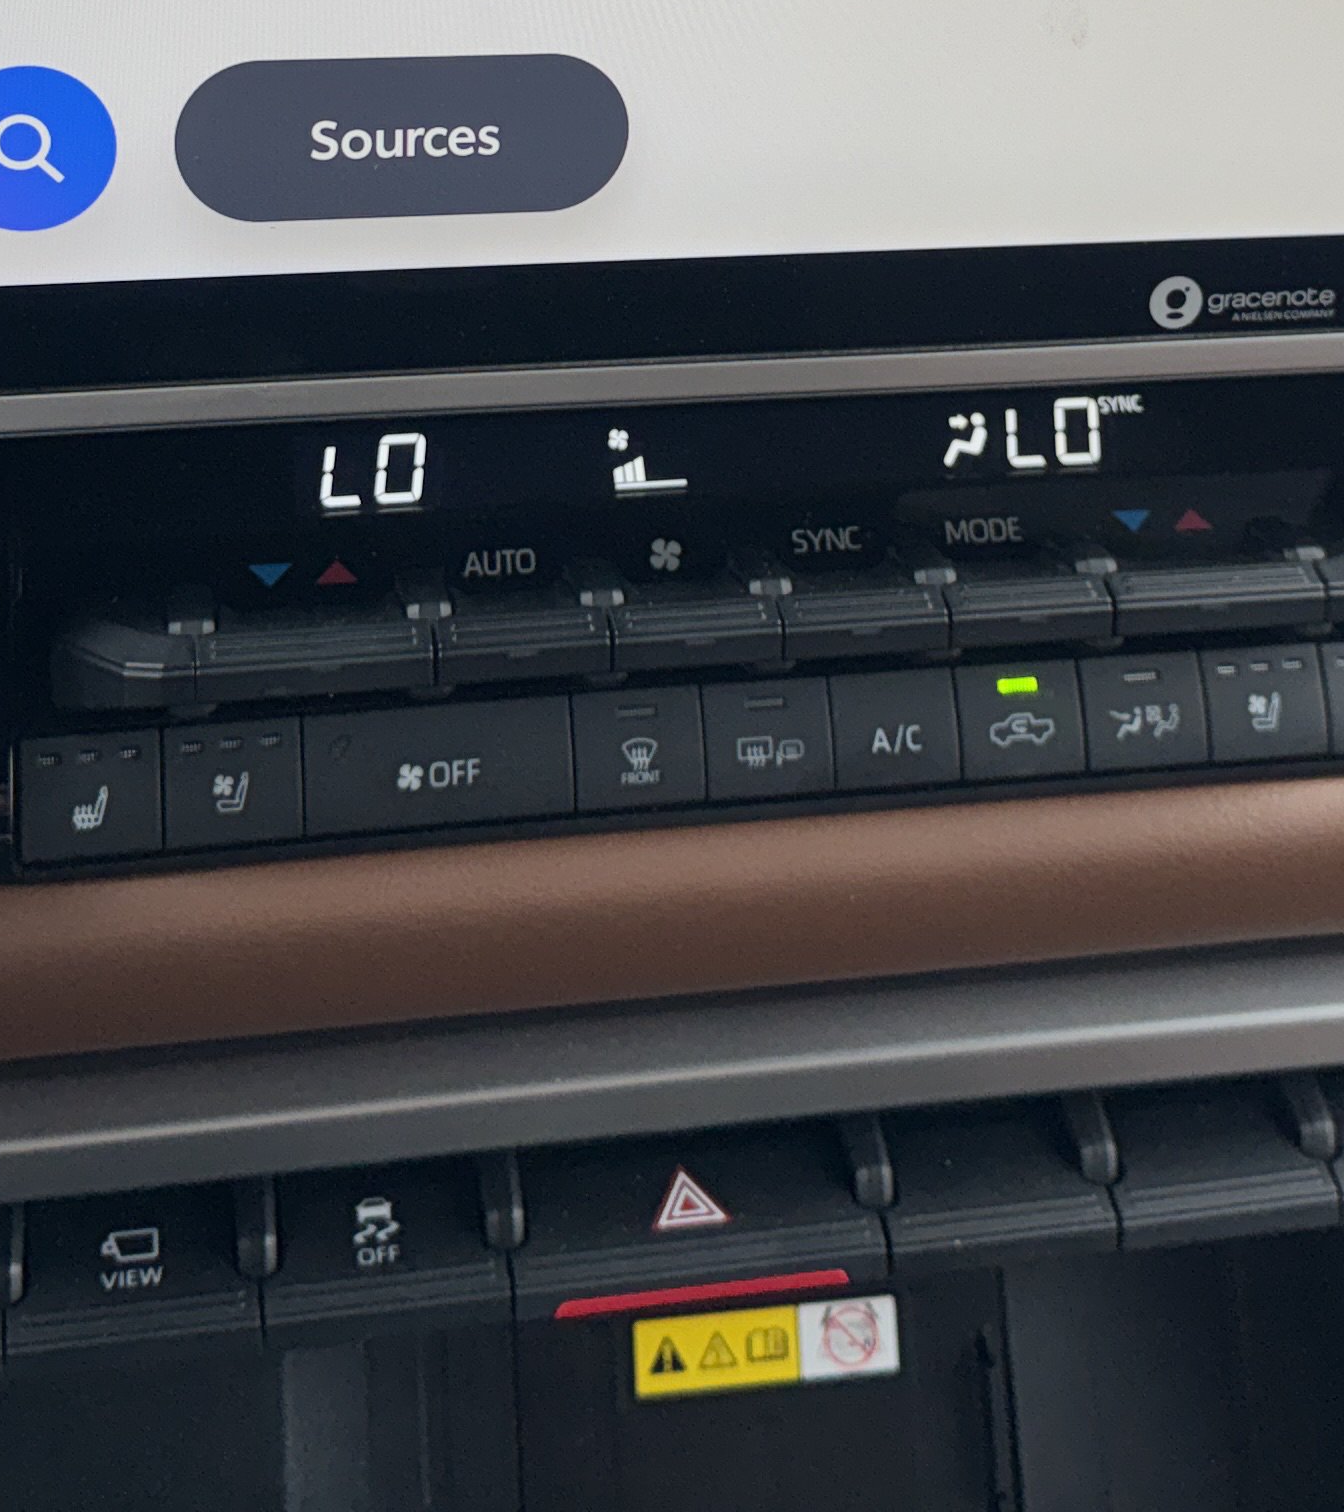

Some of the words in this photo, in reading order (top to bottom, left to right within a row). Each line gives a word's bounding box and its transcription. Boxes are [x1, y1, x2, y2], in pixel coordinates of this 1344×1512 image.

[310, 120, 501, 161] Sources
[1207, 287, 1335, 314] gracenote
[1097, 395, 1143, 414] SYNC
[792, 527, 862, 554] SYNC
[945, 515, 1023, 543] MODE
[463, 548, 536, 577] AUTO
[871, 724, 922, 754] A/C
[428, 759, 481, 789] OFF
[621, 769, 660, 785] FRONT
[356, 1245, 400, 1266] OFF
[100, 1266, 164, 1289] VIEW
